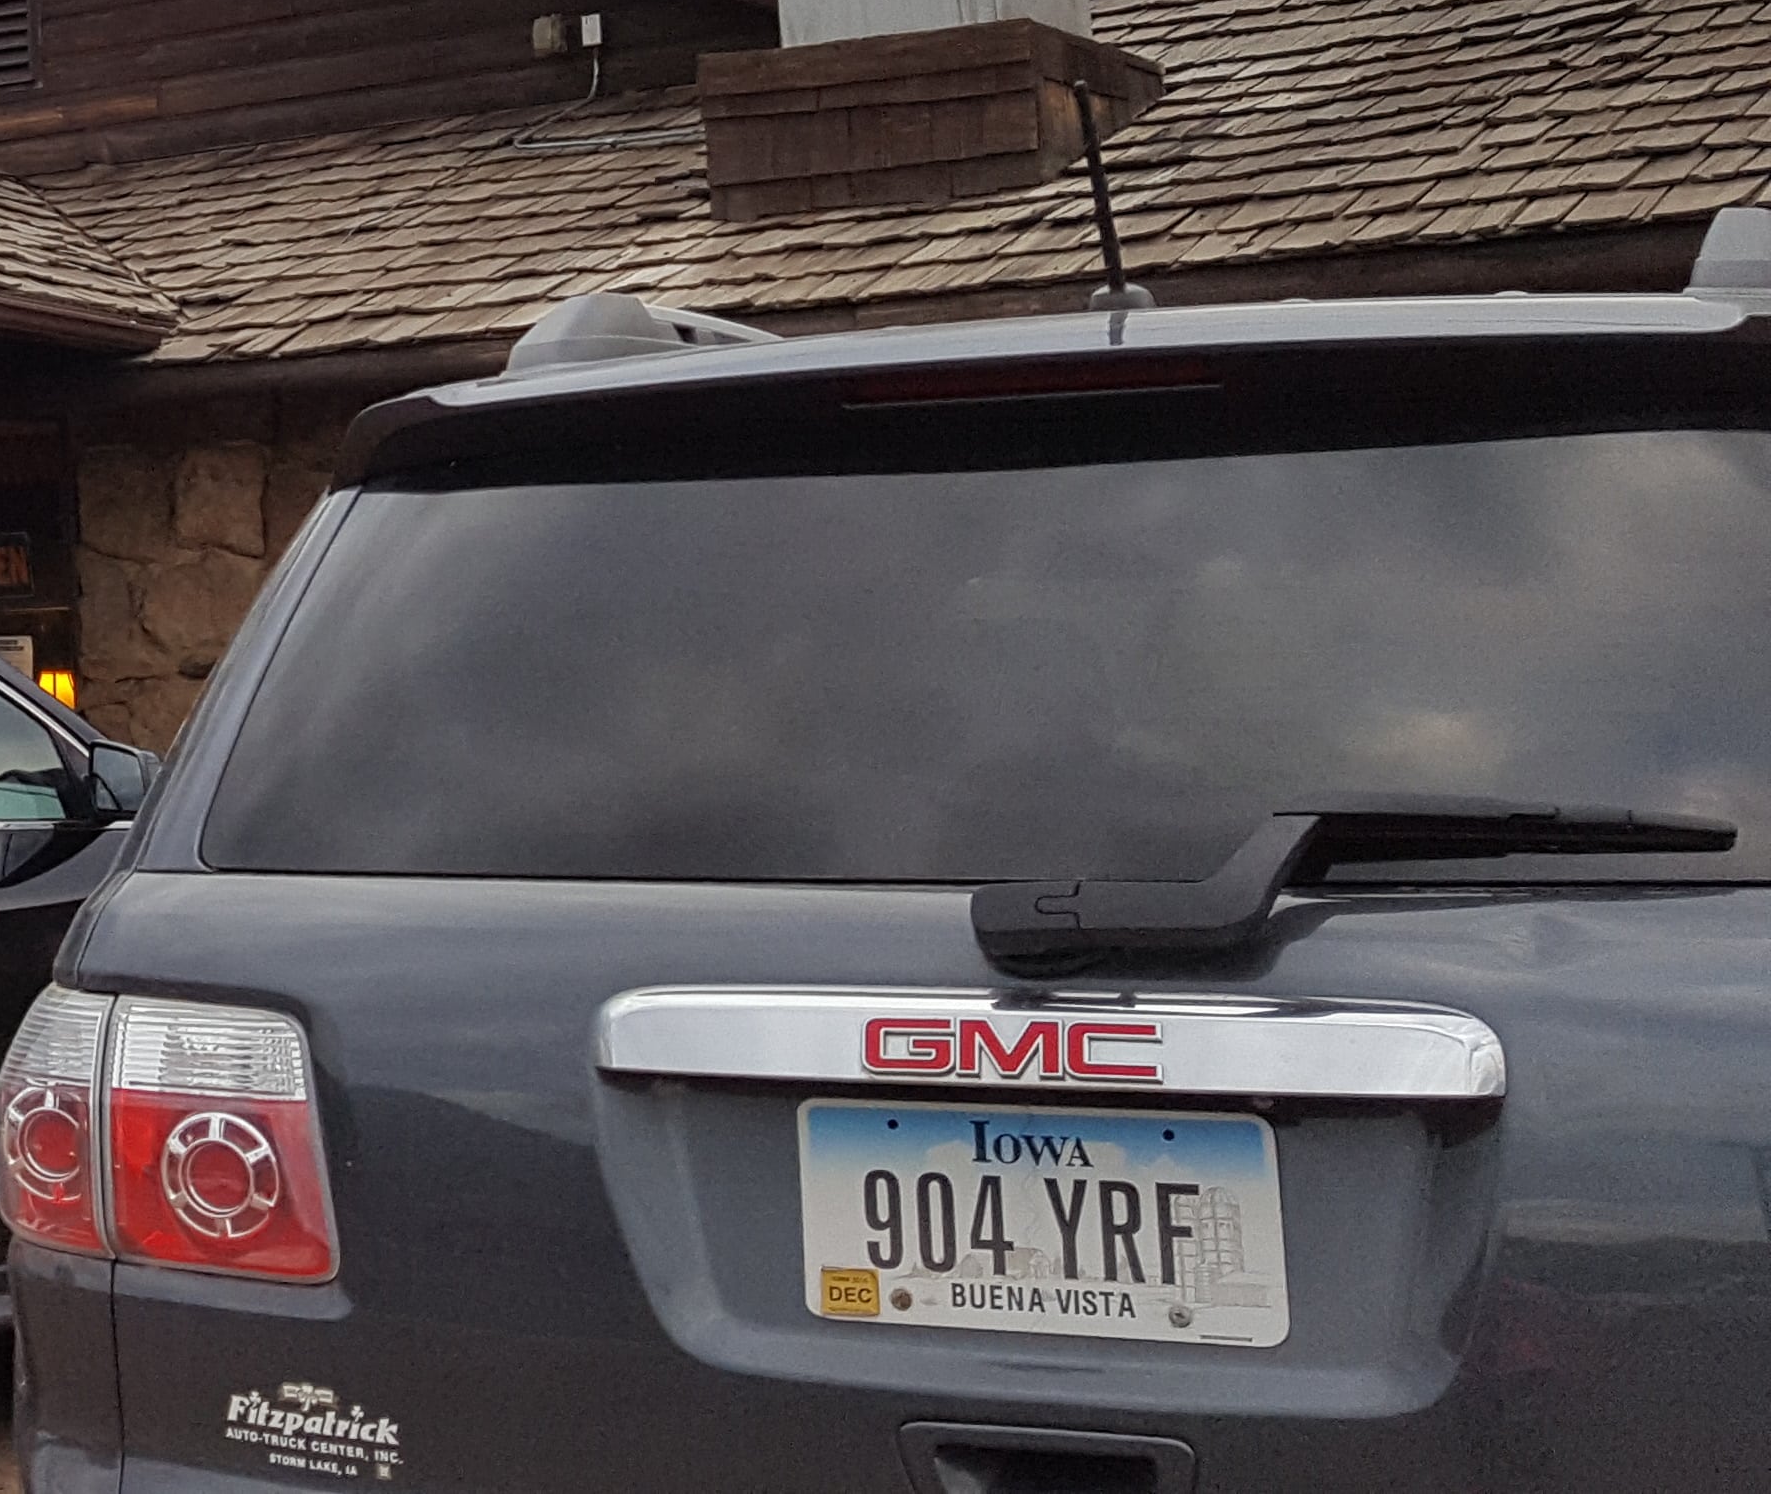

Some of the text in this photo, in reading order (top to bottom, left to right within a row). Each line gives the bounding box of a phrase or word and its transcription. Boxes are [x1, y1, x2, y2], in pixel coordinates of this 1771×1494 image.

[862, 1017, 1164, 1084] GMC
[863, 1169, 1201, 1285] 904 YRF
[829, 1286, 873, 1304] DEC
[950, 1282, 1137, 1319] BUENA VISTA
[227, 1390, 400, 1446] Fitzpatrick
[225, 1427, 405, 1465] AUTO-TRUCK CENTER, INC.
[269, 1452, 359, 1476] STORM LAKE, IA
